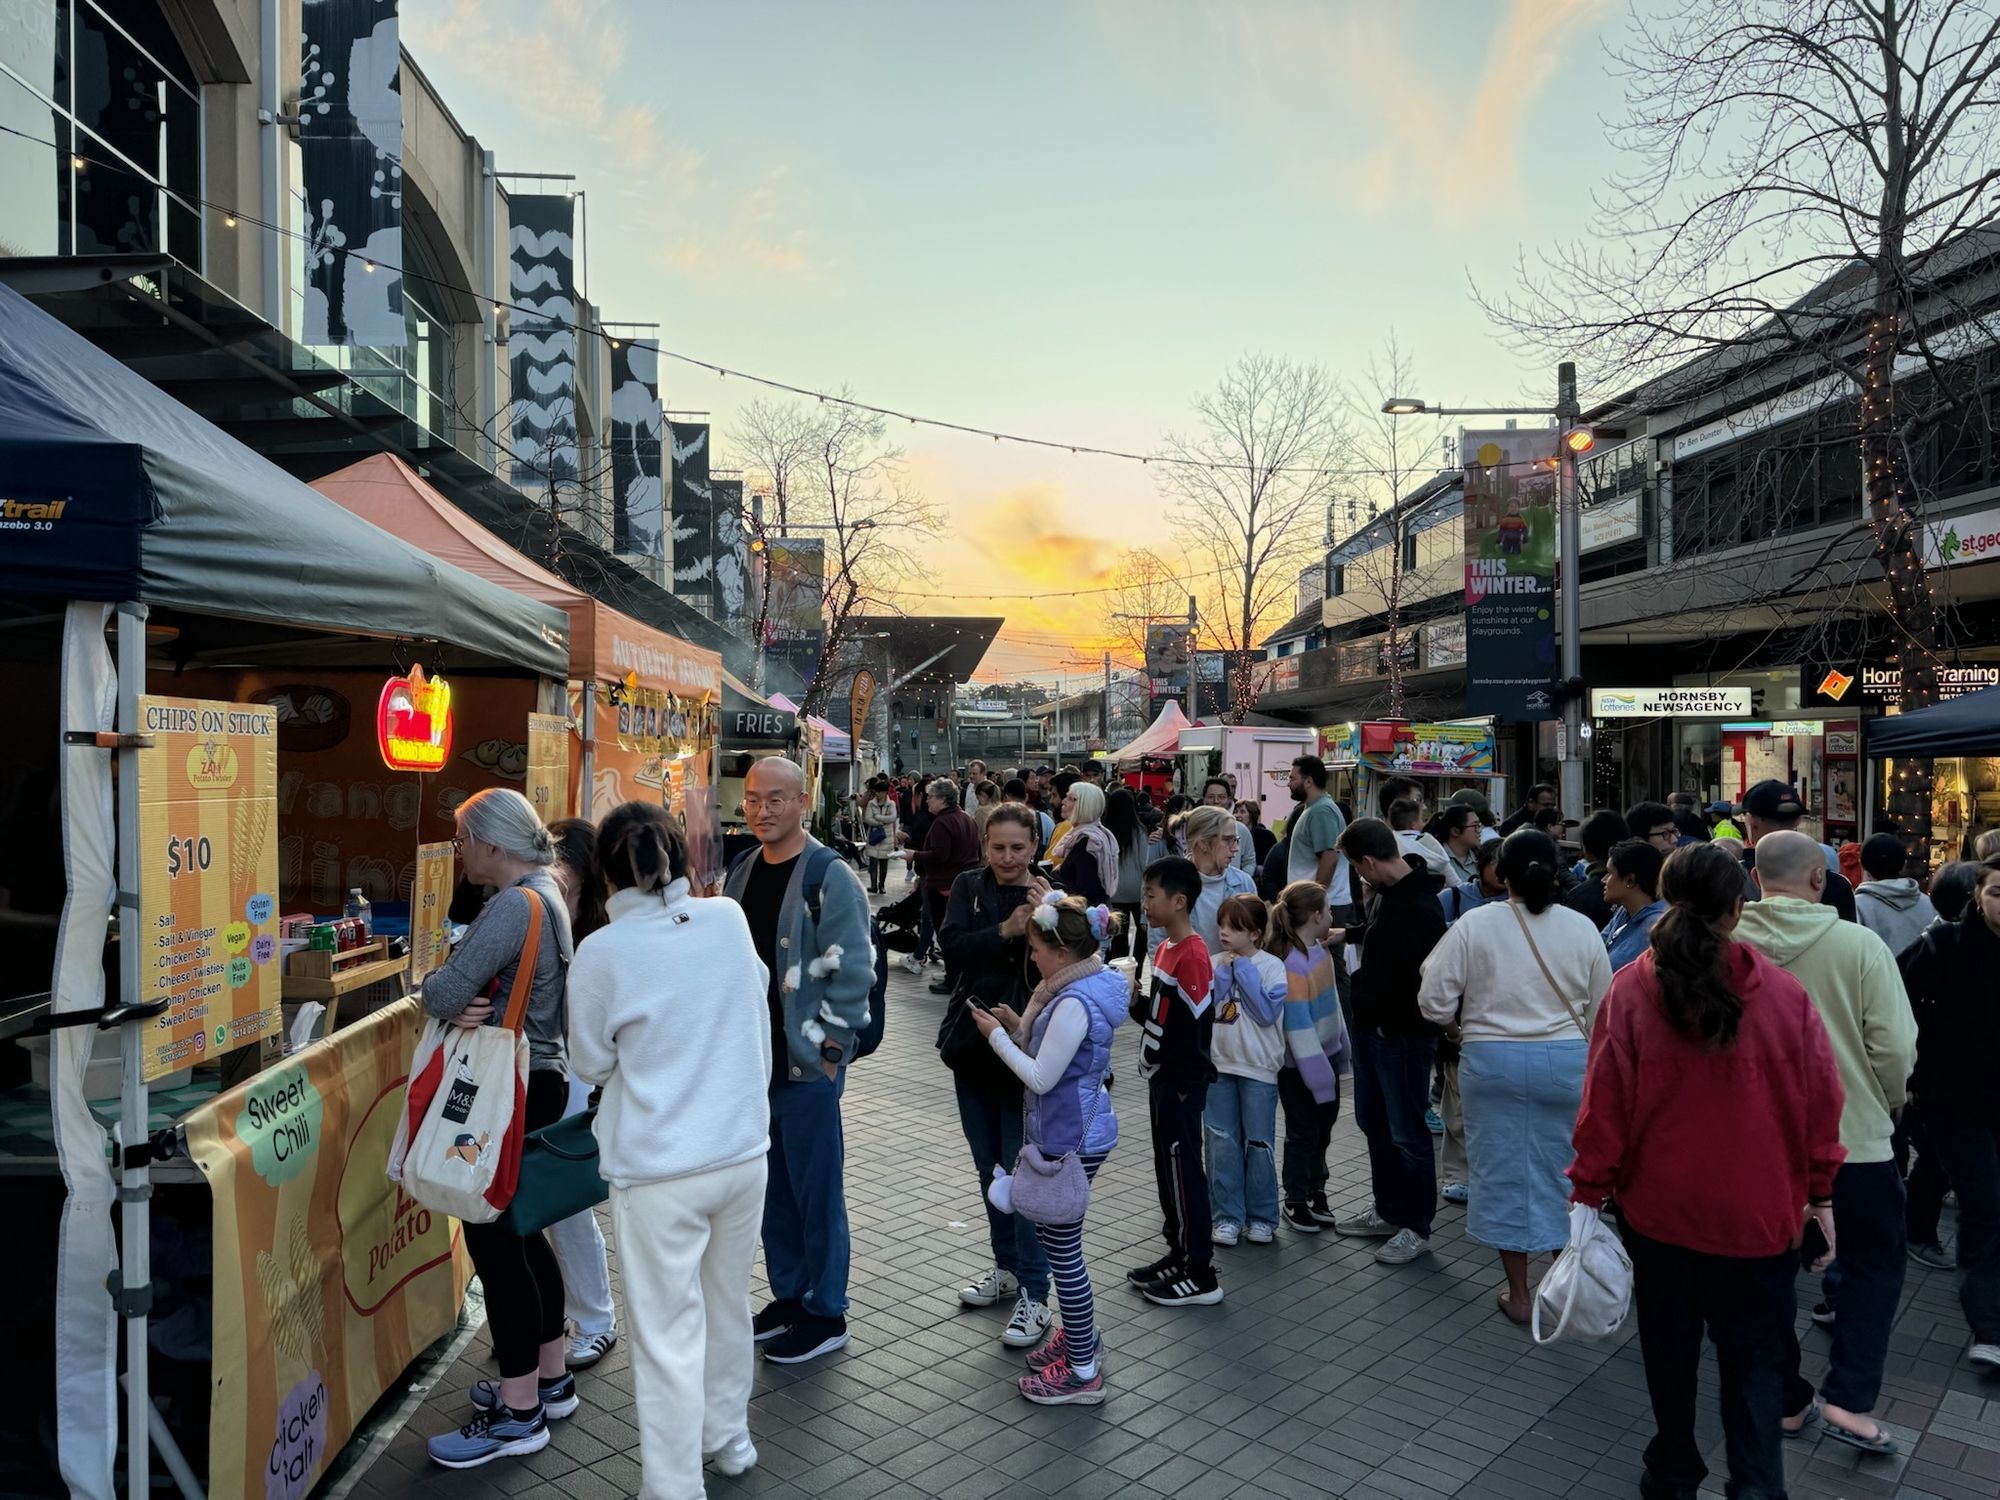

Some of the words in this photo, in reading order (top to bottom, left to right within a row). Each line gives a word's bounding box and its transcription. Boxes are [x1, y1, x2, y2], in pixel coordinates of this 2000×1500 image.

[1679, 442, 1687, 450] Dr
[1687, 437, 1698, 447] Ben
[1699, 427, 1722, 442] Dunster
[34, 522, 53, 531] 3.0
[1471, 558, 1507, 577] THIS
[1471, 576, 1551, 595] WINTER...
[1472, 605, 1494, 615] Enjoy
[1496, 606, 1510, 614] the
[1472, 617, 1508, 625] sunshine
[1472, 627, 1523, 636] playgrounds.
[1152, 677, 1168, 686] THIS
[1863, 667, 1901, 684] Horn
[1658, 692, 1727, 701] HORNSBY
[1600, 703, 1636, 711] Lotteries
[1643, 702, 1742, 712] NEWSAGENCY
[146, 706, 197, 732] CHIPS
[201, 711, 225, 733] ON
[228, 713, 271, 735] STICK
[736, 712, 783, 734] FRIES
[1829, 744, 1855, 752] Lotteries
[535, 786, 549, 803] $10
[168, 836, 211, 879] $10
[250, 900, 270, 910] Gluten
[423, 893, 435, 909] $10
[159, 912, 176, 929] Salt
[254, 911, 267, 920] Free
[159, 932, 176, 949] Salt
[178, 932, 184, 944] &
[186, 926, 217, 942] Vinegar
[227, 932, 246, 944] Vegan
[256, 939, 270, 950] Dairy
[159, 951, 193, 969] Chicken
[195, 945, 211, 960] Salt
[257, 951, 270, 960] Free
[232, 961, 247, 972] Nuts
[159, 971, 191, 989] Cheese
[193, 962, 225, 980] Twisties
[232, 973, 247, 984] Free
[166, 993, 186, 1008] oney
[189, 982, 222, 1000] Chicken
[160, 1013, 187, 1029] Sweet
[188, 1003, 209, 1020] Chilli
[248, 1073, 306, 1130] Sweet
[273, 1113, 310, 1162] Chili
[368, 1209, 431, 1286] Potato
[270, 1383, 324, 1475] Cicken
